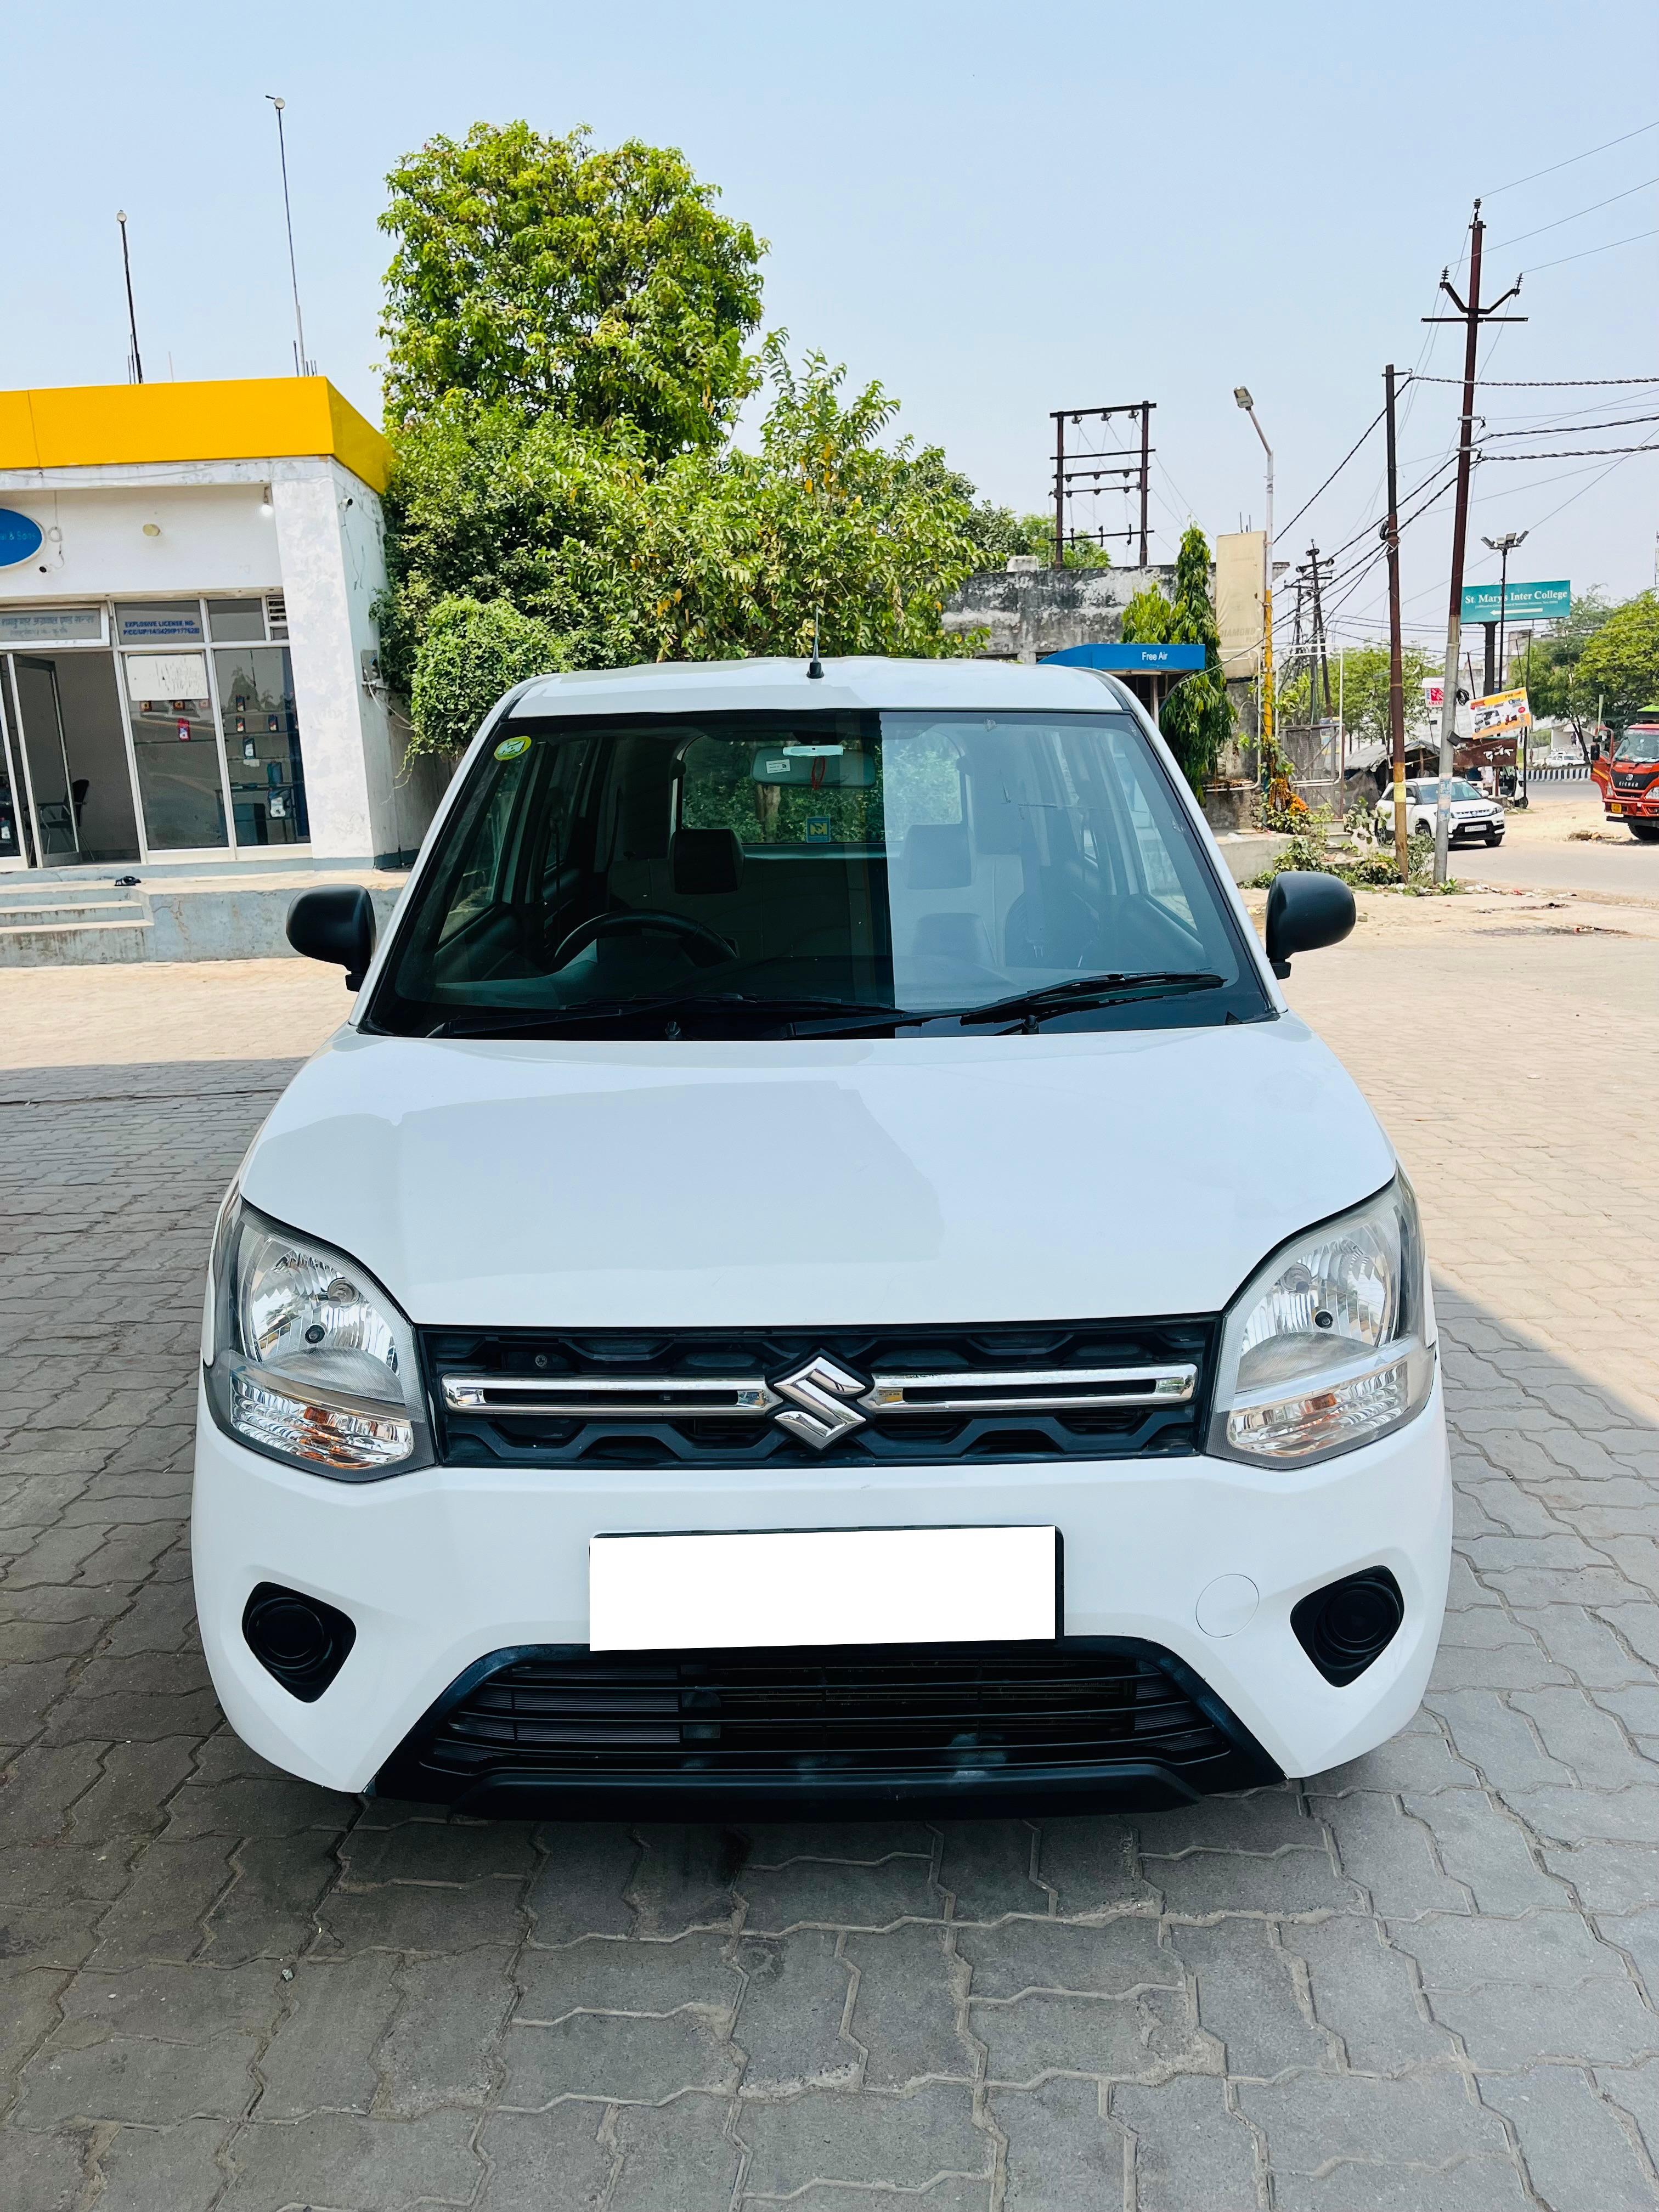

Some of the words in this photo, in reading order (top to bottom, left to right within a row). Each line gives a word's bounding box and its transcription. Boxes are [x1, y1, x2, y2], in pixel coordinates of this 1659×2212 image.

[1479, 594, 1508, 603] Marys
[1510, 592, 1532, 601] Inter
[1534, 590, 1567, 600] College
[1142, 651, 1157, 661] Free
[1158, 651, 1167, 660] Air
